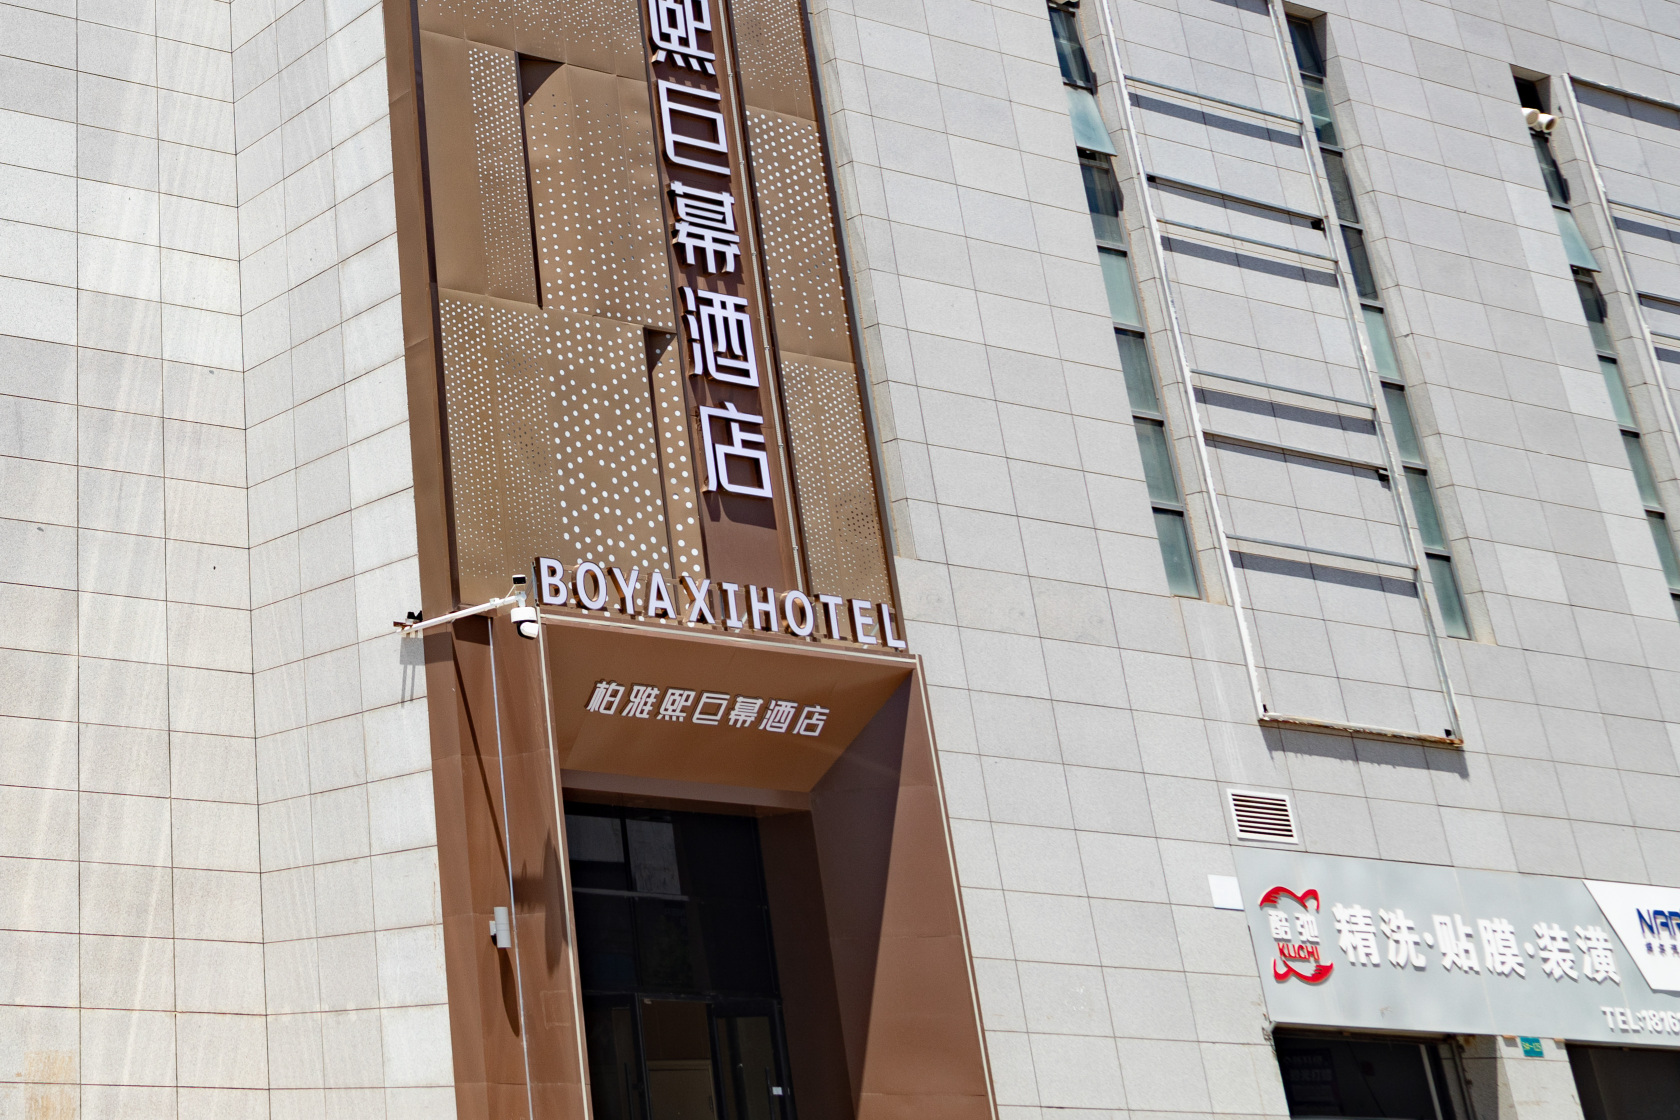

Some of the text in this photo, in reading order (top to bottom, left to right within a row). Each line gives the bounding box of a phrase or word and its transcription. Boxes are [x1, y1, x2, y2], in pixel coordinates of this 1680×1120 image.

[587, 679, 830, 737] 柏雅熙巨幕酒店
[1277, 941, 1320, 961] KUCHI
[1600, 1007, 1680, 1035] TEL:1816
